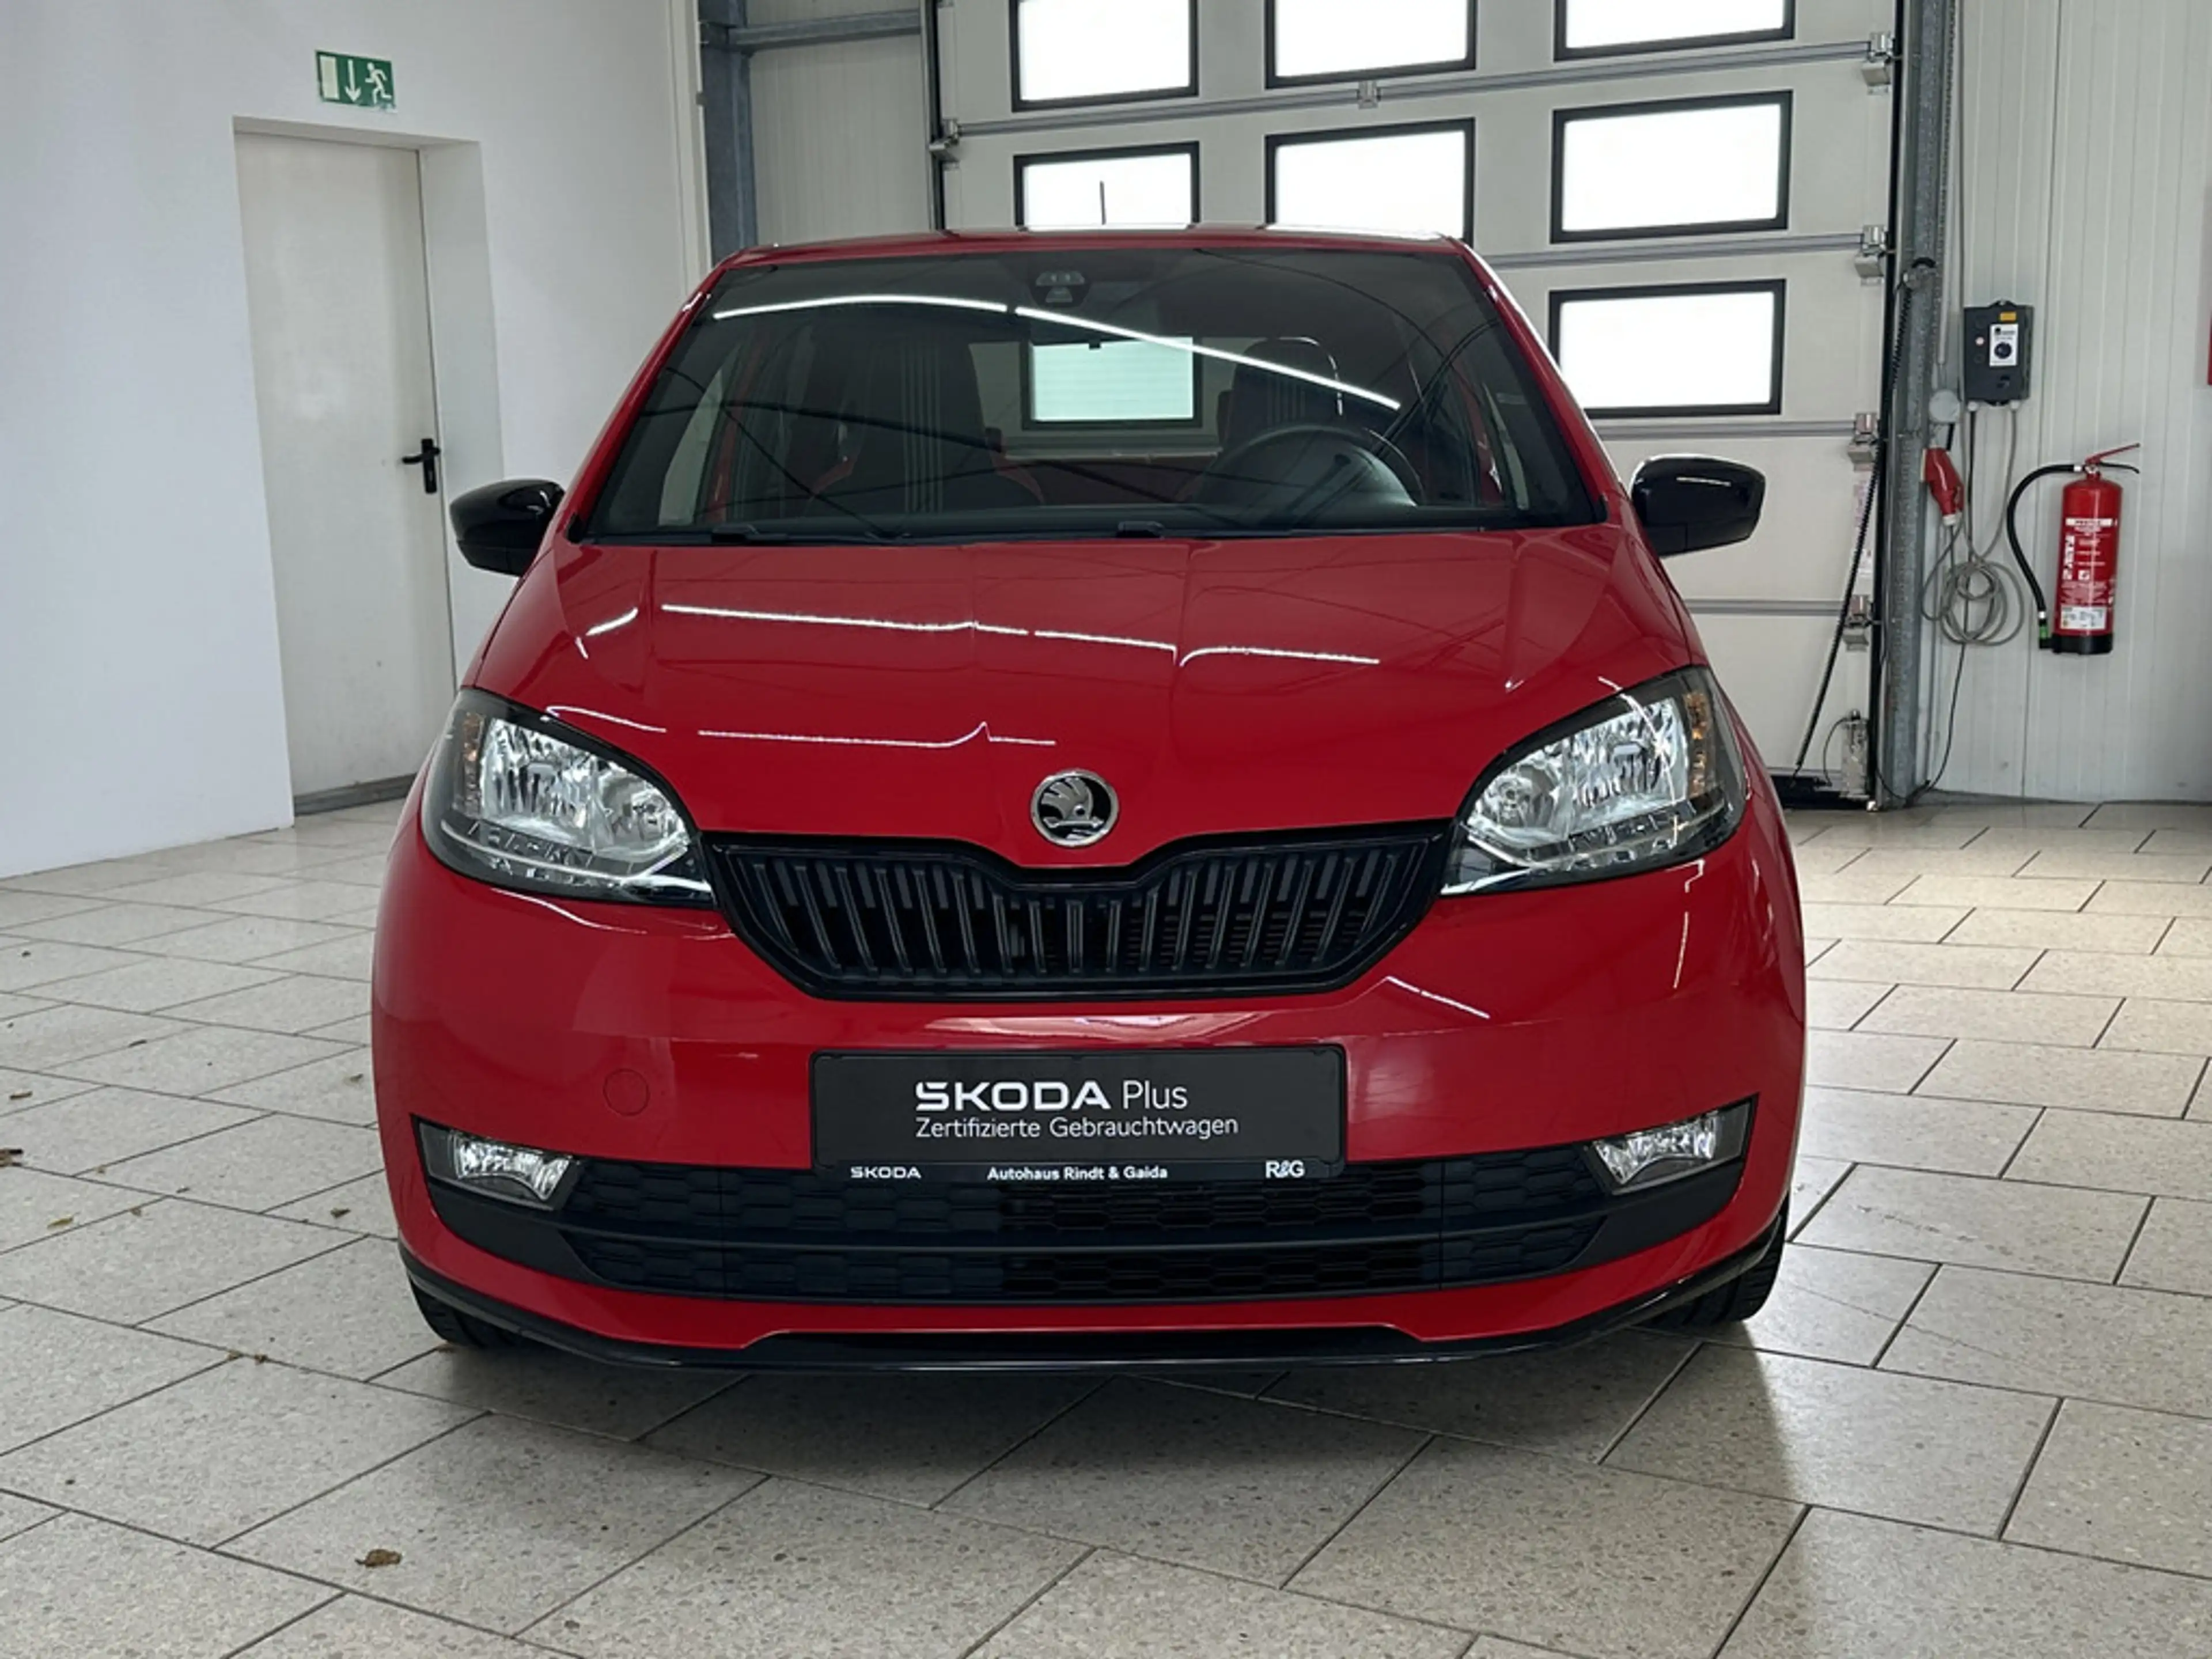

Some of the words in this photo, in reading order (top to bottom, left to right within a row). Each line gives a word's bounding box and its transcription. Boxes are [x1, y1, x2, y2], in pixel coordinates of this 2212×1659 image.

[1123, 1080, 1188, 1109] Plus
[915, 1117, 1040, 1138] Zertifizierte
[1049, 1116, 1238, 1140] Gebrauchtwagen
[987, 1166, 1059, 1180] Autohaus
[1064, 1166, 1104, 1180] Rindt
[1108, 1165, 1119, 1179] &
[1123, 1165, 1168, 1179] Gaida
[1265, 1160, 1305, 1179] R&G
